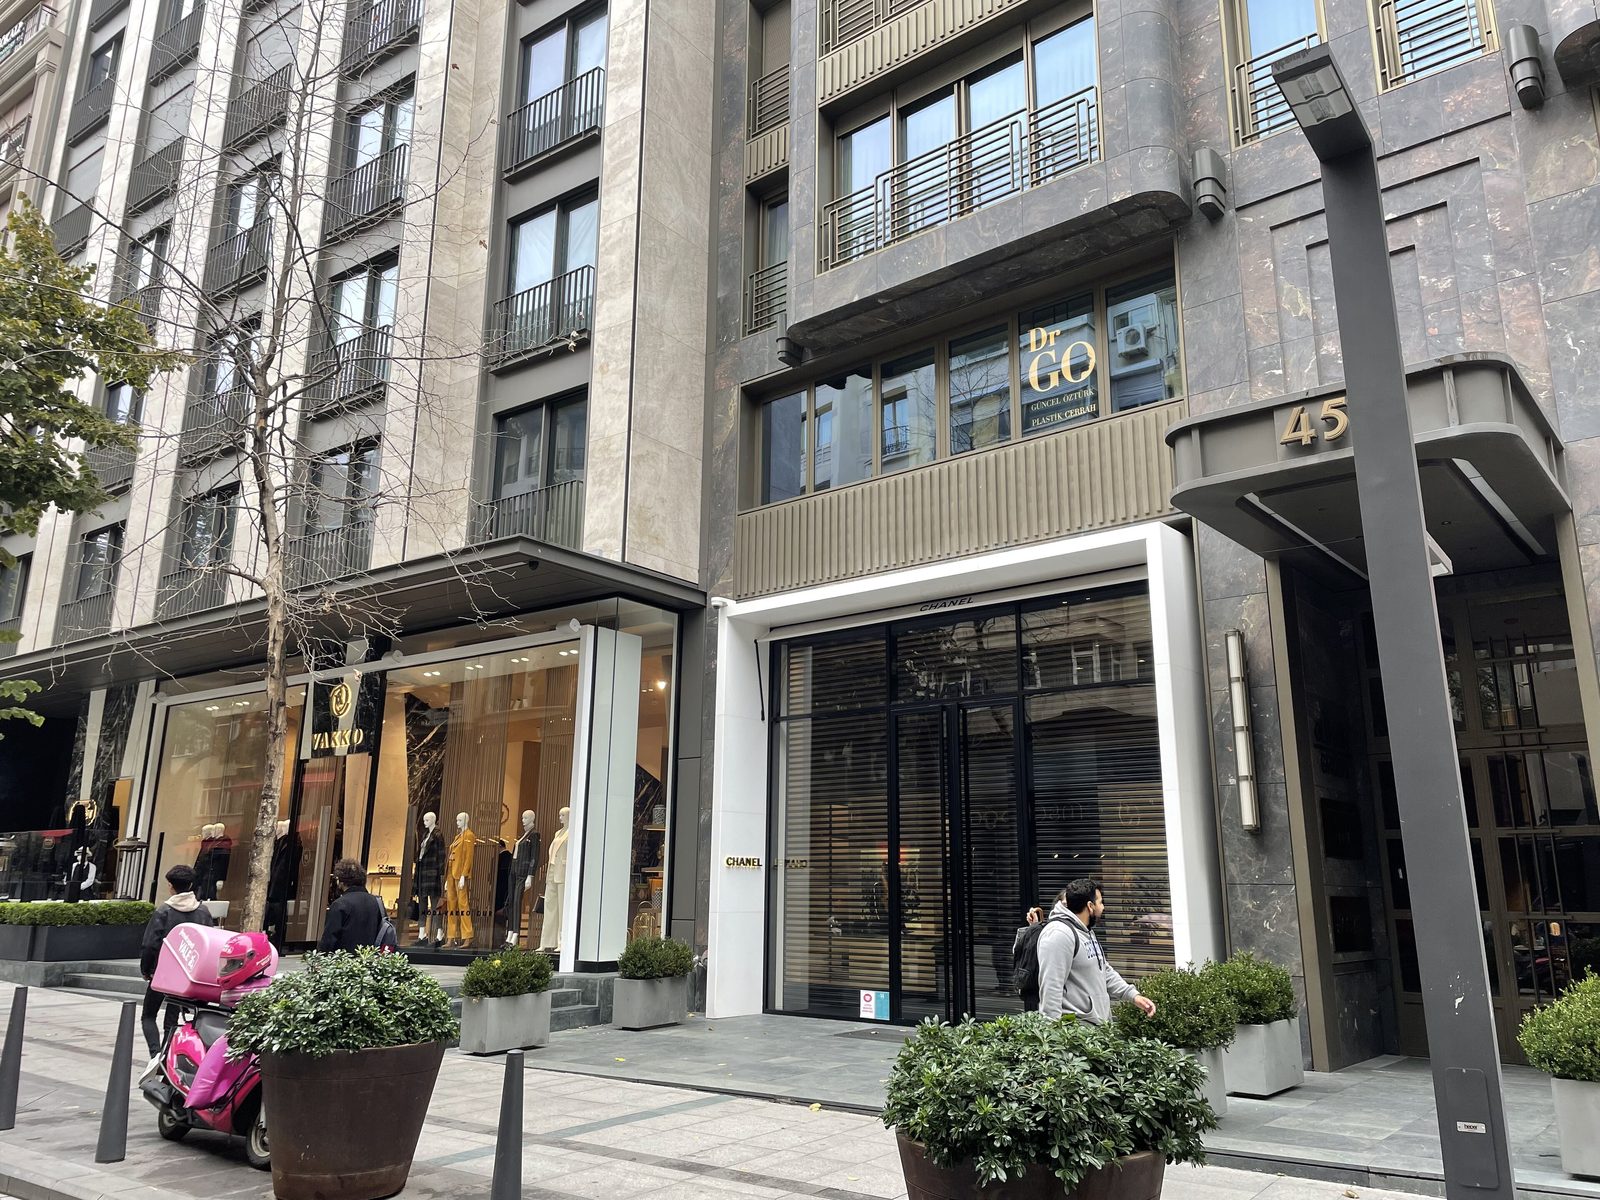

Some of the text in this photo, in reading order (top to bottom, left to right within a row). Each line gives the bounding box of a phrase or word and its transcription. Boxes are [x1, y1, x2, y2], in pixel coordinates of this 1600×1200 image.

[1028, 327, 1060, 353] Dr
[1028, 341, 1096, 392] GO
[1031, 388, 1095, 411] GÜNCEL ÖZTÜRK
[1032, 403, 1096, 426] PLASTİK CERRAH
[1280, 396, 1349, 445] 45
[920, 597, 974, 611] CHANEL
[312, 728, 364, 751] VAKKO
[725, 856, 763, 868] CHANEL
